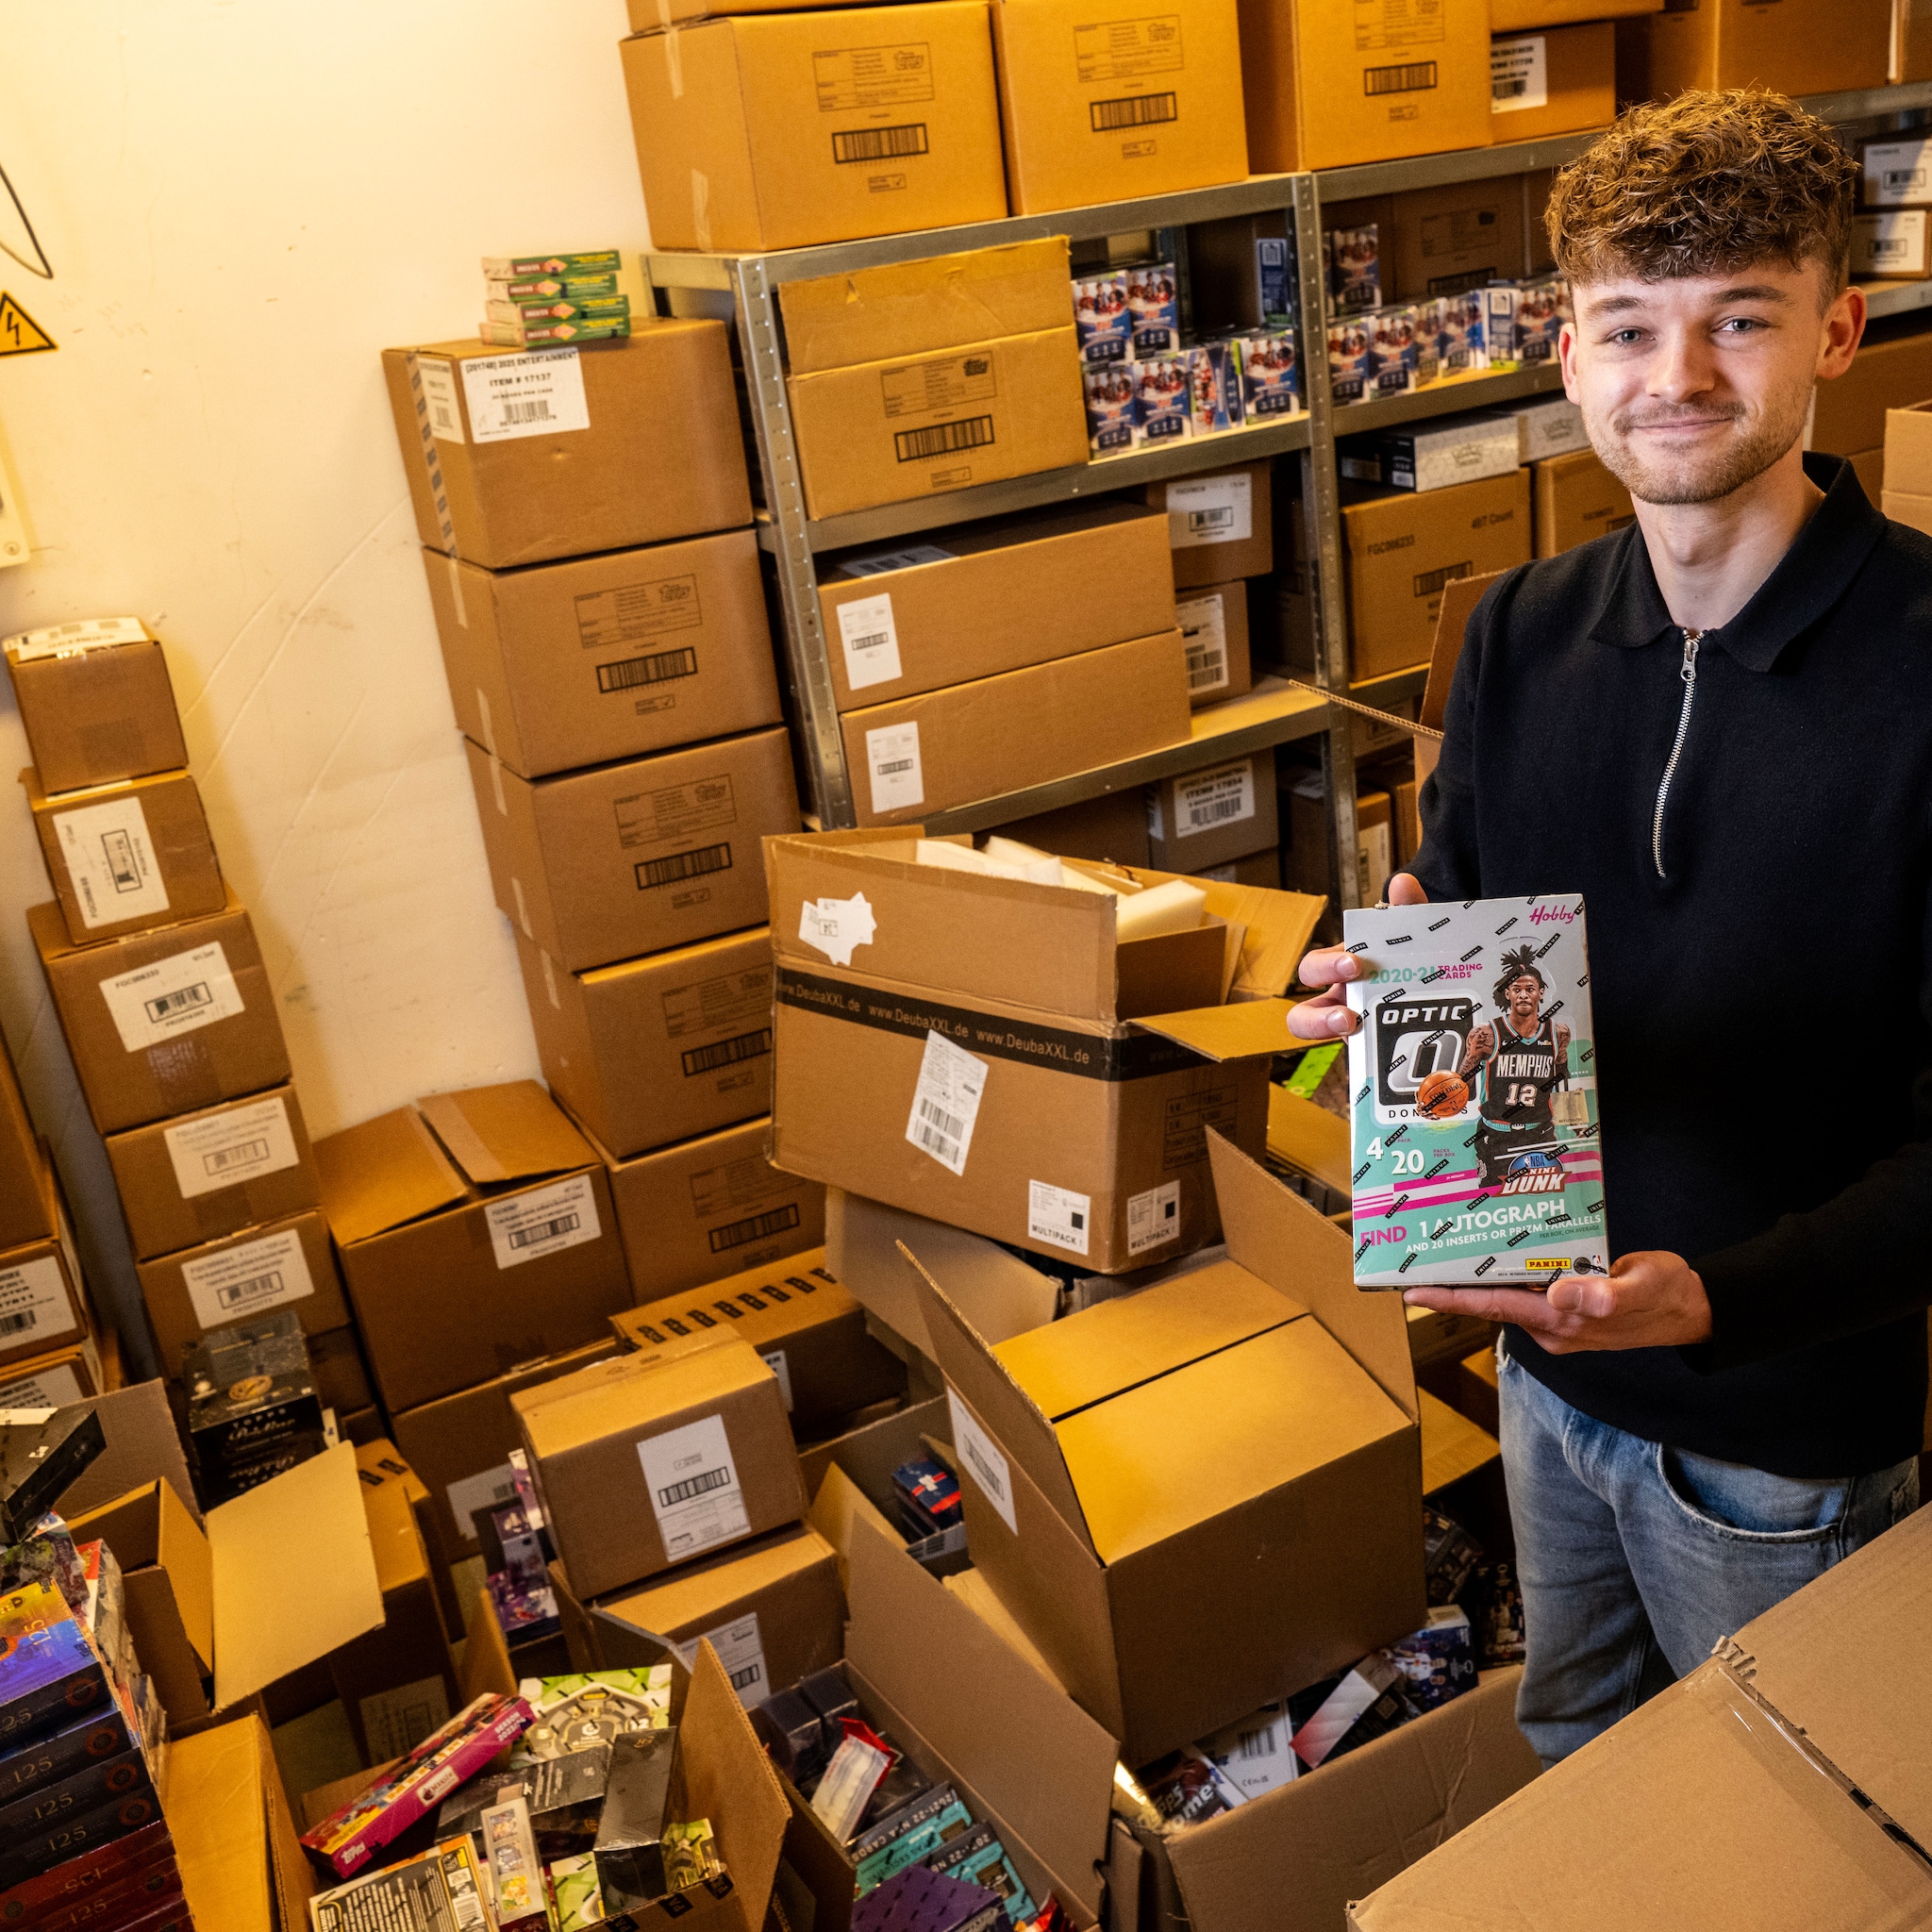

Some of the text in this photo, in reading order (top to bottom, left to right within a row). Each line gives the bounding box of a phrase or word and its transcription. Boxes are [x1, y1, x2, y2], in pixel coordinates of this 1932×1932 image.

[489, 378, 513, 388] ITEM
[1529, 905, 1576, 926] Hobby
[1369, 966, 1436, 985] 2020-21
[1438, 963, 1484, 974] TRADING
[1439, 971, 1472, 980] CARDS
[1381, 1005, 1468, 1024] OPTIC
[869, 1004, 969, 1038] www.DeubaXXL.de
[976, 1028, 1090, 1065] www.DeubaXXL.de
[1496, 1054, 1554, 1078] MEMPHIS
[1505, 1082, 1538, 1108] 12
[1389, 1106, 1469, 1119] DONS
[1366, 1136, 1384, 1161] 4
[1391, 1148, 1425, 1175] 20
[1530, 1155, 1545, 1167] NBA
[1501, 1173, 1568, 1195] DUNK
[1420, 1198, 1566, 1238] 1 AUTOGRAPH
[1032, 1224, 1076, 1245] MULTIPACK
[1131, 1228, 1171, 1250] MULTIPACK
[1360, 1225, 1407, 1246] FIND
[1405, 1214, 1602, 1254] AND 20 INSERTS OR PRIZM PARALLELS
[1528, 1259, 1569, 1268] PANINI
[24, 1619, 51, 1646] 125
[2, 1707, 32, 1732] 25
[492, 1710, 521, 1736] SEASON
[13, 1756, 53, 1783] 125
[34, 1792, 74, 1820] 125
[48, 1825, 87, 1852] 125
[888, 1820, 911, 1838] NA
[850, 1834, 888, 1863] CARDS
[70, 1898, 108, 1924] 125
